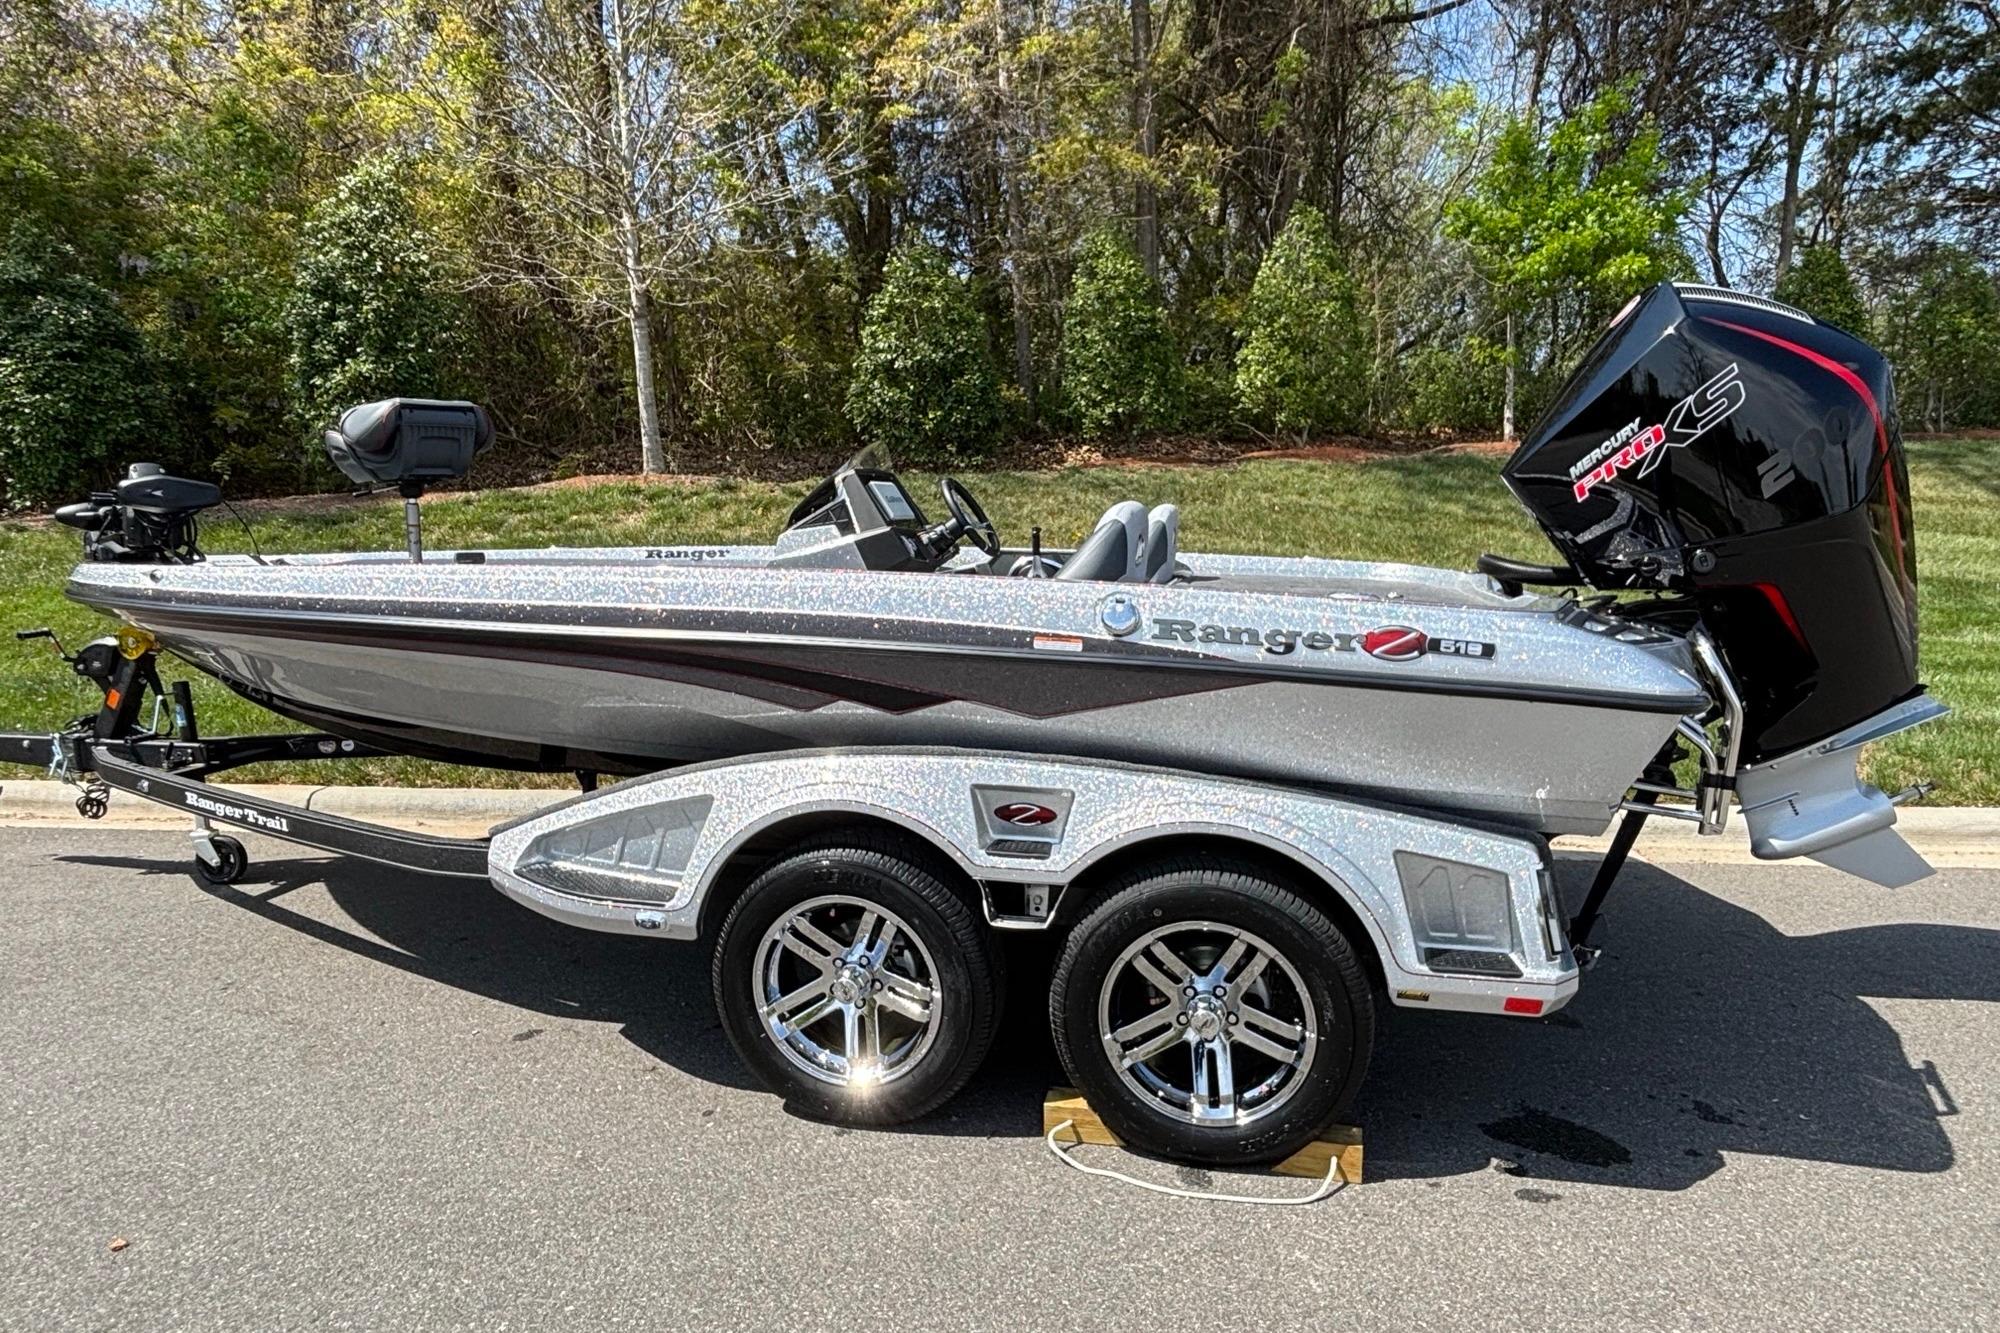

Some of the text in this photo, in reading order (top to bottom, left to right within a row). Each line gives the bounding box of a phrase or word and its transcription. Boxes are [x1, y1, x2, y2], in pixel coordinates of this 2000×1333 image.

[1569, 416, 1641, 480] MERCURY
[1573, 424, 1666, 503] PRO
[645, 549, 730, 561] Ranger
[1151, 618, 1366, 656] Ranger
